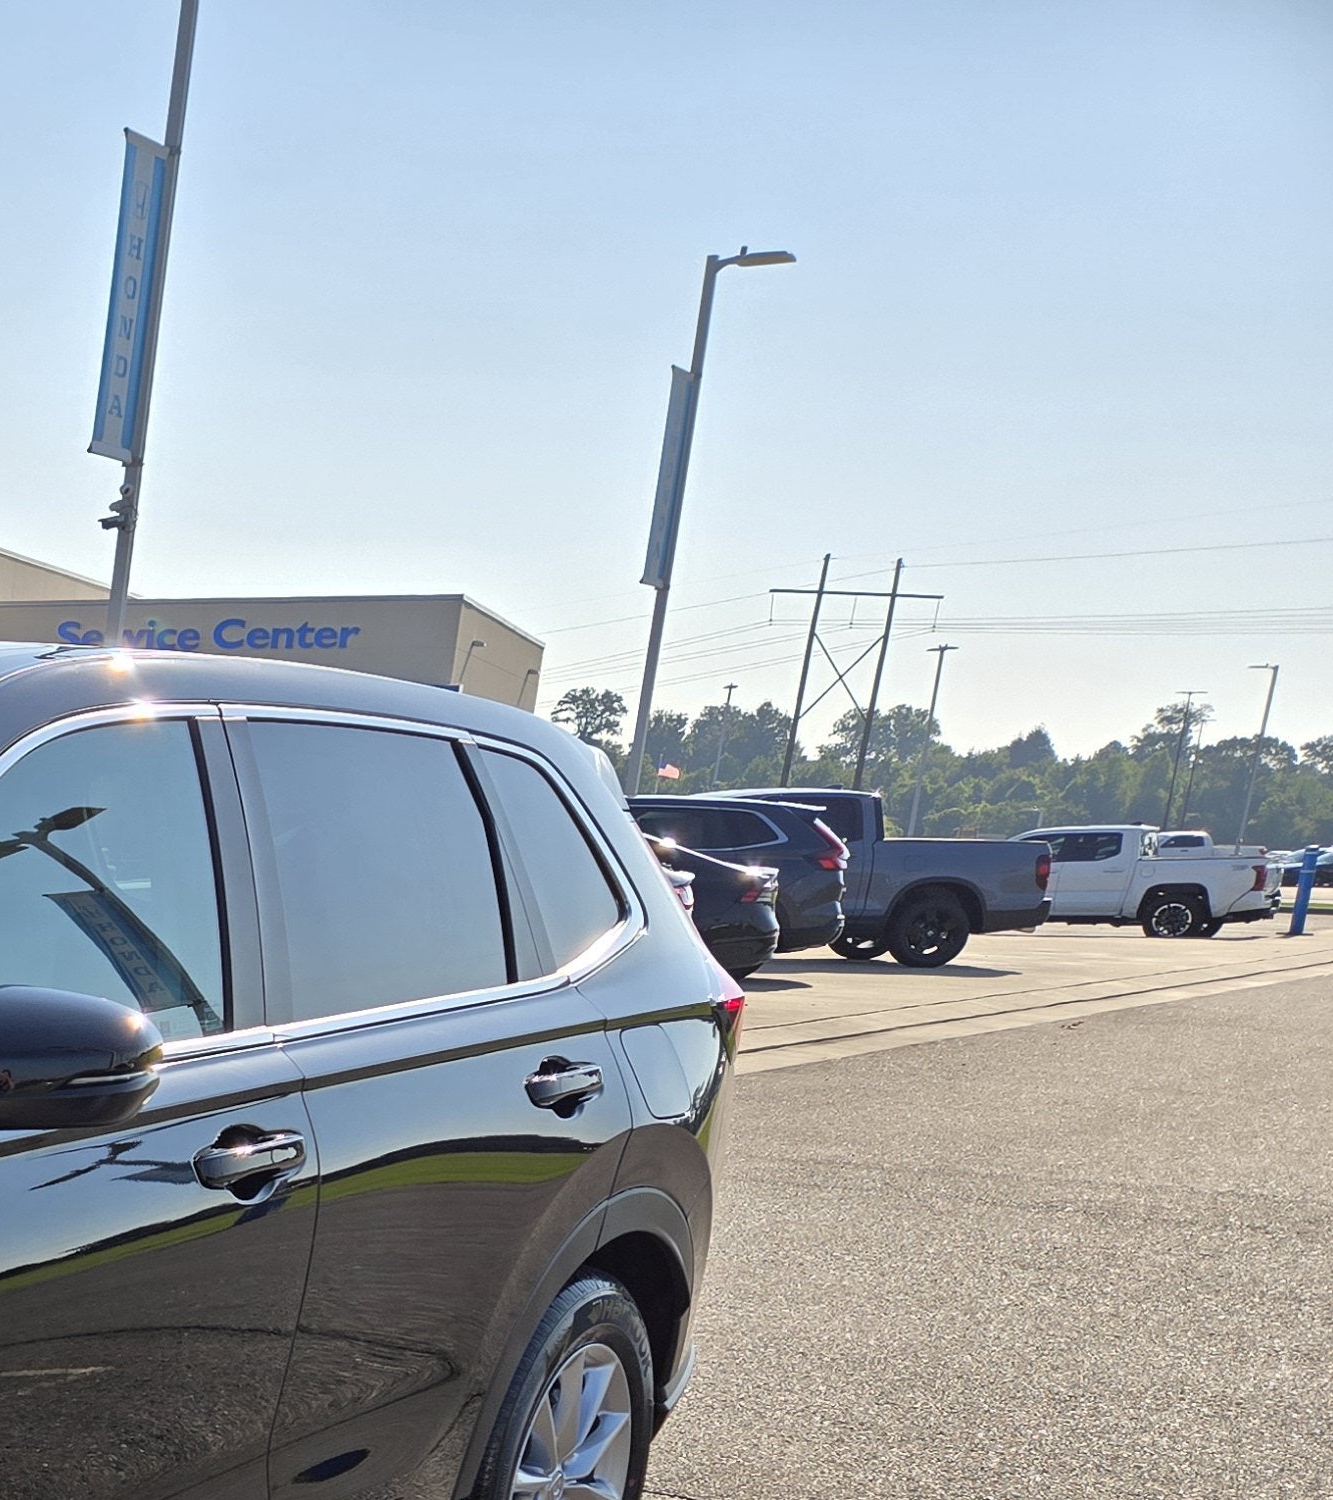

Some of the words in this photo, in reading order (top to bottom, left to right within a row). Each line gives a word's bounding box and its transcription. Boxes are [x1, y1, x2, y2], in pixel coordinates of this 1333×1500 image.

[108, 234, 144, 418] HONDA
[57, 619, 201, 650] Sevice
[213, 618, 361, 650] Center
